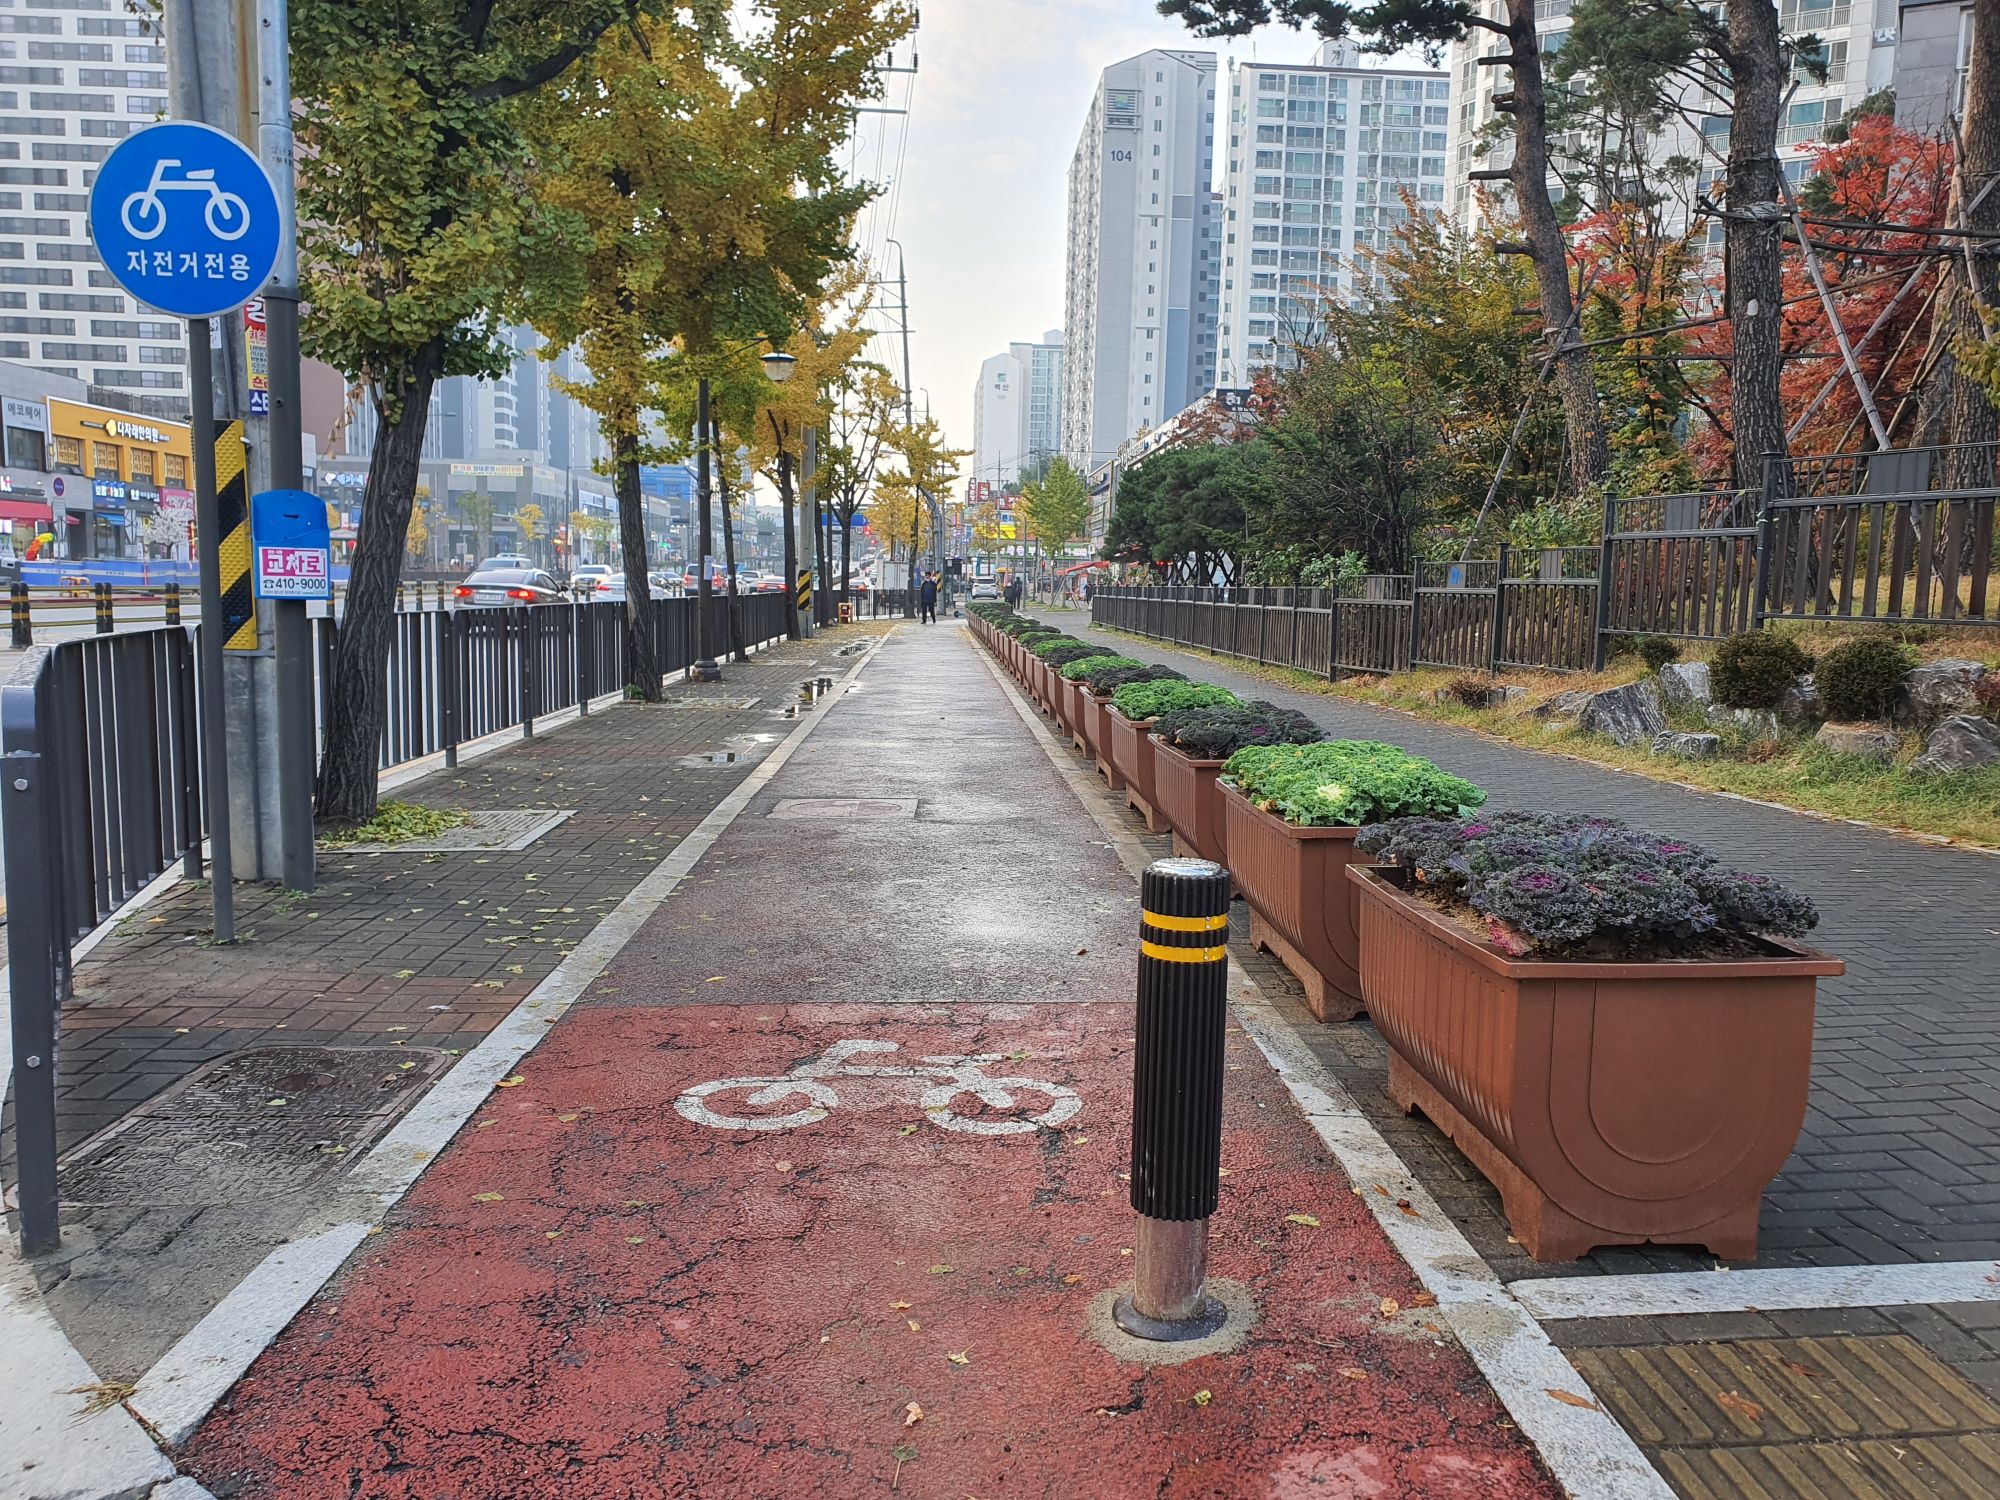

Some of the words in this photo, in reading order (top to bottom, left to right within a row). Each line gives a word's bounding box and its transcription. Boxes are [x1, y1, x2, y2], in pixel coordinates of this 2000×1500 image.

[1110, 149, 1132, 162] 104
[126, 249, 250, 281] 자전거전용
[266, 553, 321, 573] 교차로
[275, 578, 326, 589] 410-9000
